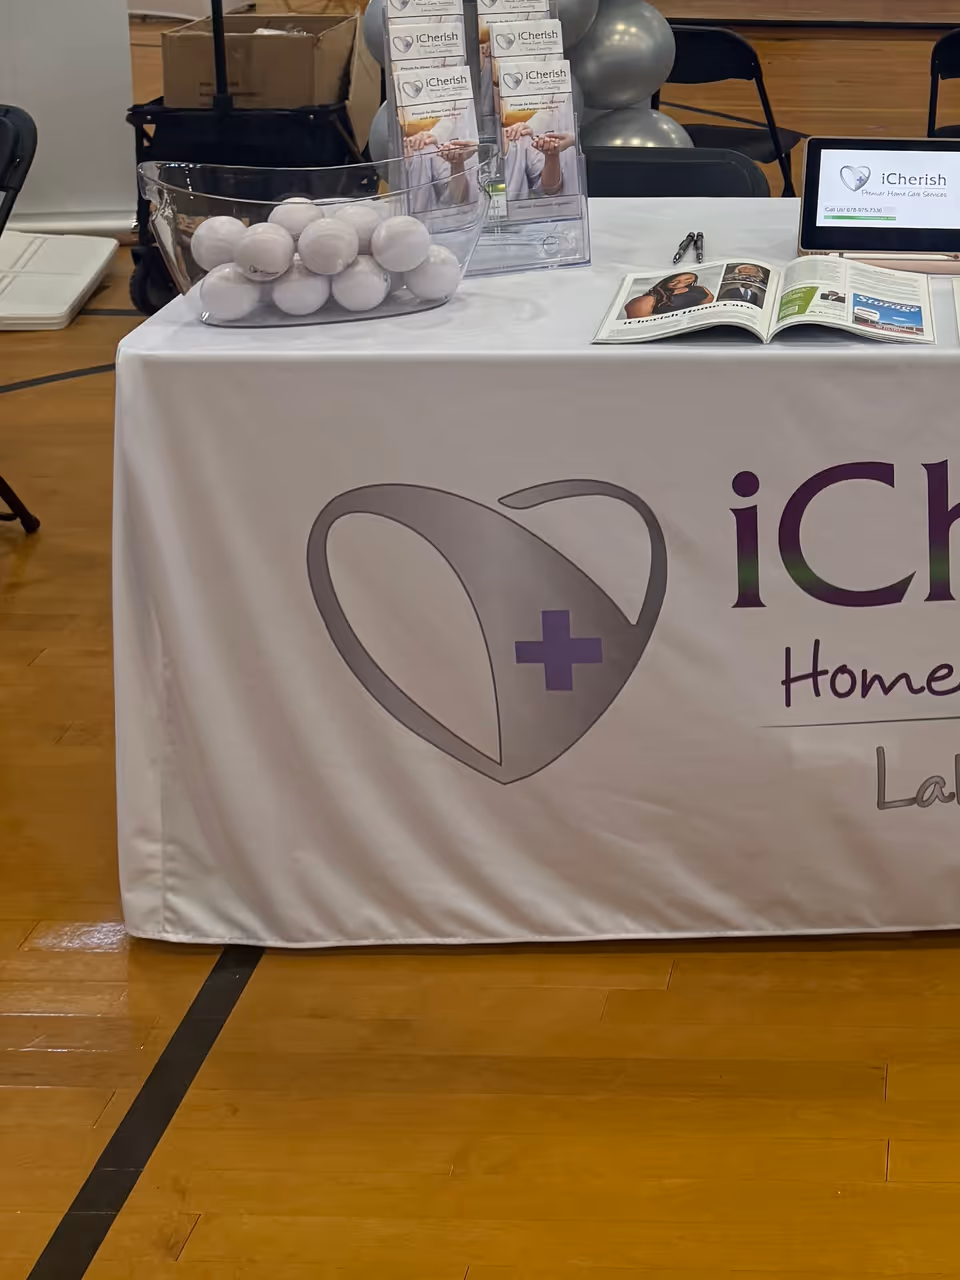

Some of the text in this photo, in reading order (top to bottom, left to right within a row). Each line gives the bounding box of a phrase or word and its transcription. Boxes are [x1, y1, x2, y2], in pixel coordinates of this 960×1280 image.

[416, 32, 458, 43] iCherish
[518, 30, 558, 40] iCherish
[526, 69, 566, 79] iCherish
[426, 75, 466, 87] iCherish
[882, 172, 946, 186] iCherish
[856, 295, 919, 312] Storage
